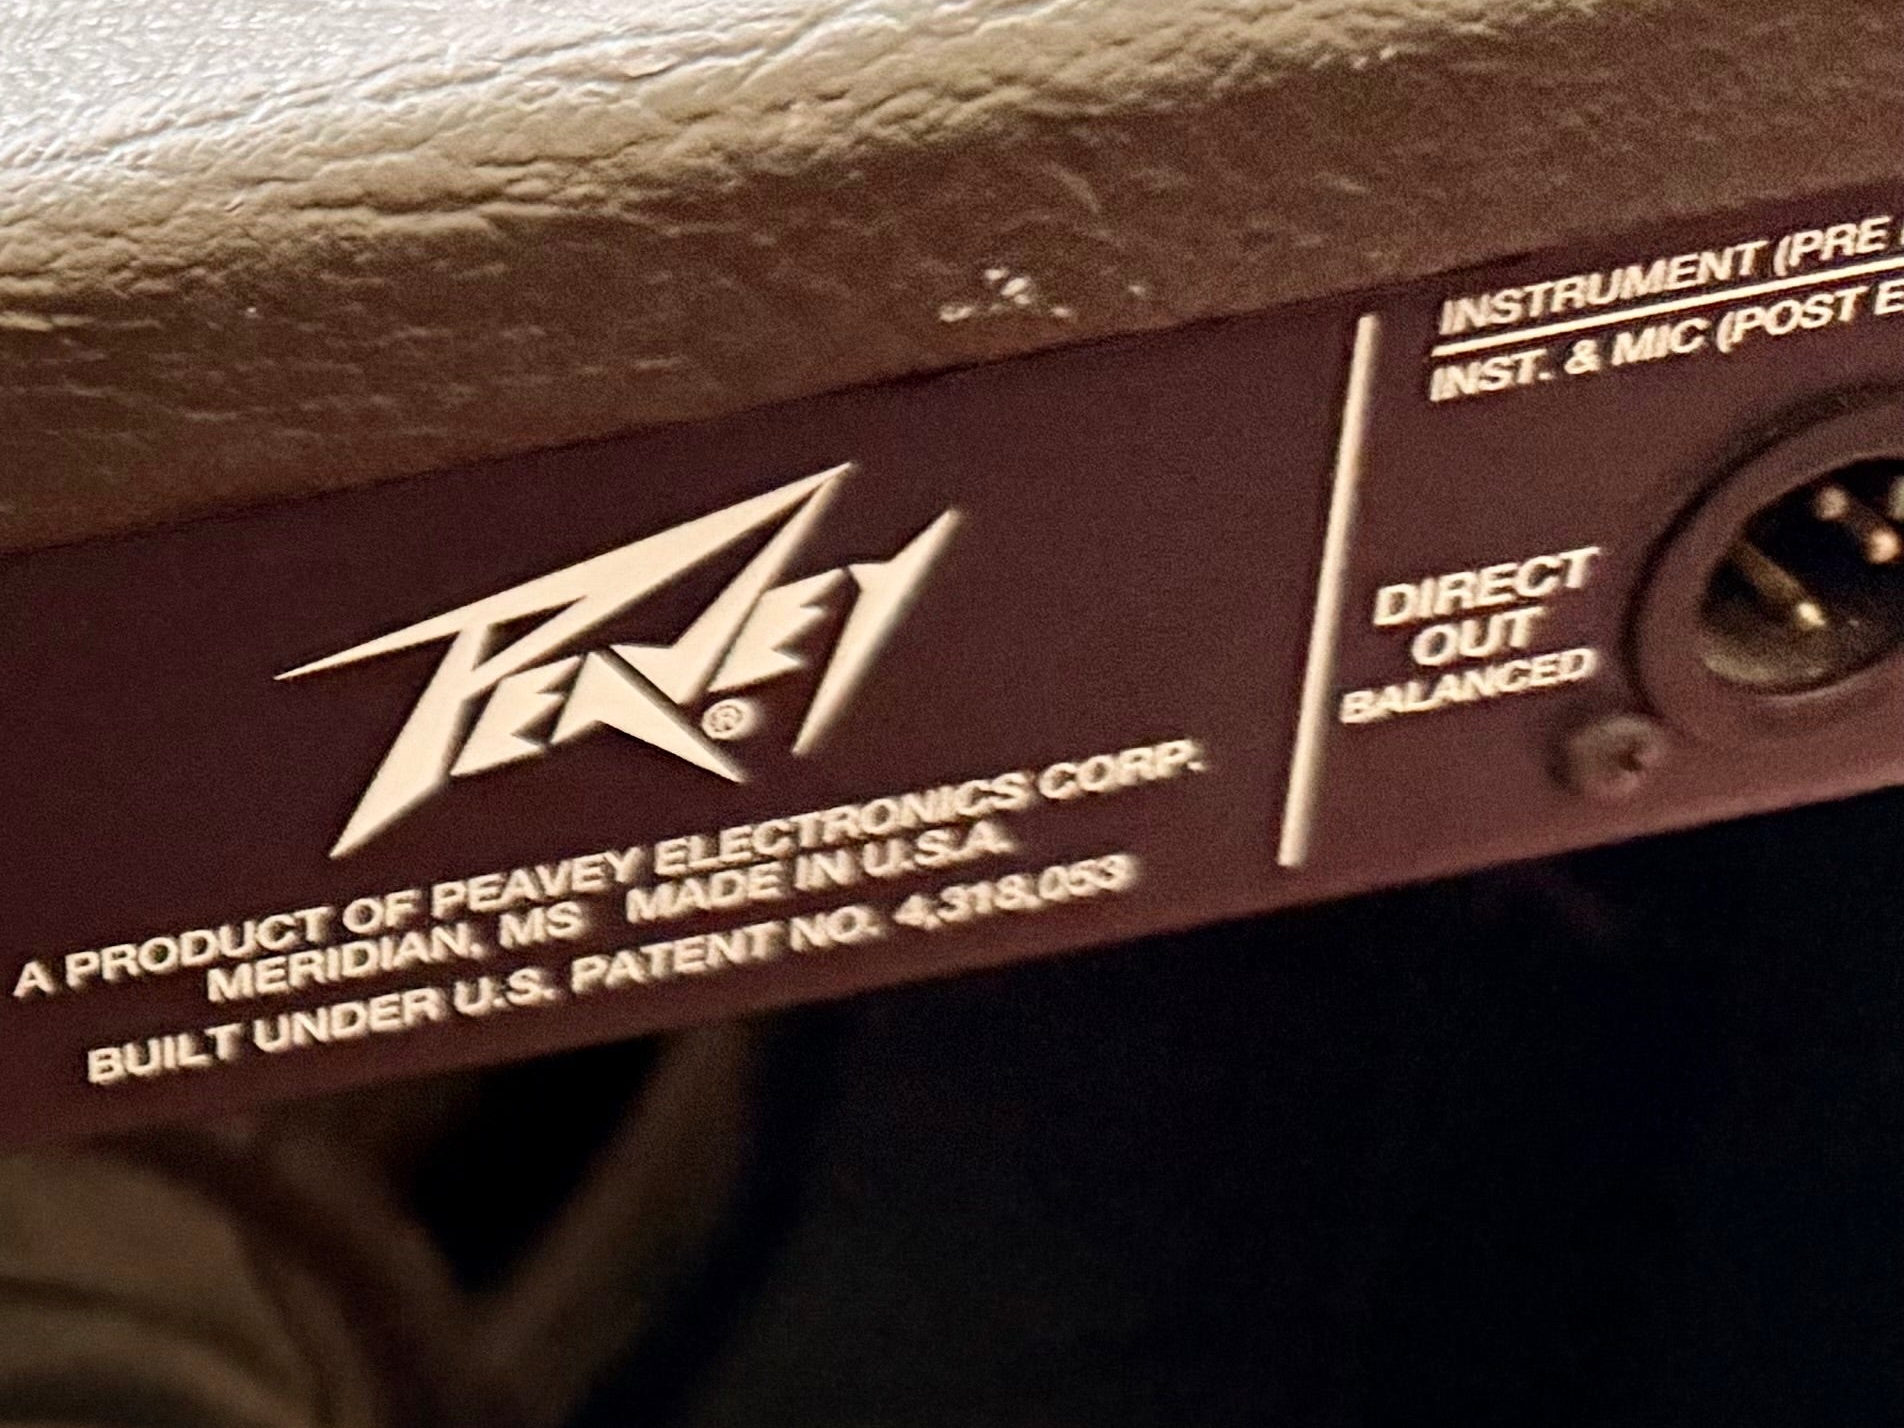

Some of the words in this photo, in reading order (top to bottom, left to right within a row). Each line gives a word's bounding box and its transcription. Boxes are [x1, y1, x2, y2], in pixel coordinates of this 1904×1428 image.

[1440, 240, 1769, 336] INSTRUMENT
[1773, 215, 1892, 278] (PRE
[1430, 348, 1554, 403] INST.
[1564, 338, 1601, 375] &
[1611, 318, 1711, 366] MIC
[1716, 285, 1869, 353] (POST
[1373, 545, 1602, 627] DIRECT
[1410, 605, 1547, 667] OUT
[273, 460, 961, 858] PEAVEY
[1340, 646, 1599, 724] BALANCED
[12, 960, 57, 999] A
[65, 905, 335, 988] PRODUCT
[342, 888, 423, 935] OF
[430, 845, 645, 920] PEAVEY
[654, 770, 1032, 878] ELECTRONICS
[1037, 738, 1207, 801] CORP.
[498, 899, 590, 950] MS
[626, 859, 788, 925] MADE
[795, 845, 859, 891] IN
[87, 1023, 244, 1085] BUILT
[252, 985, 449, 1056] UNDER
[451, 966, 556, 1019] U.S.
[570, 919, 788, 995] PATENT
[790, 904, 886, 950] NO.
